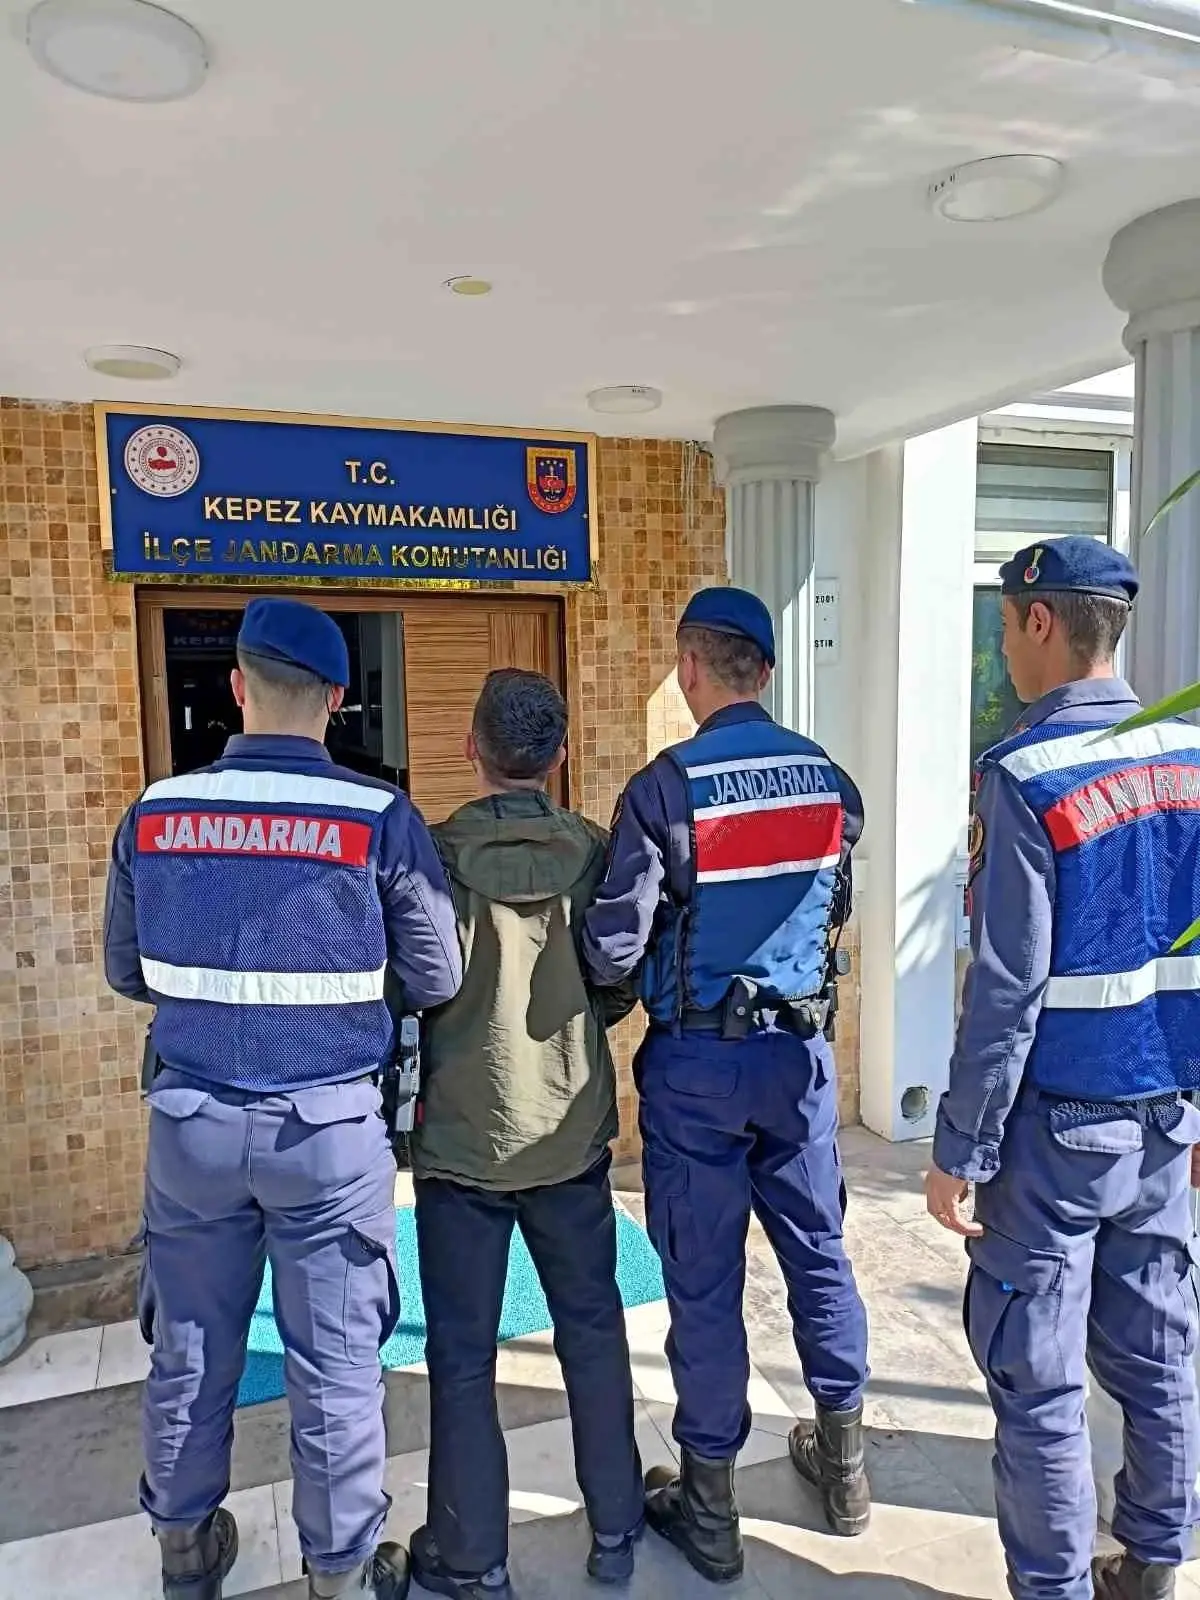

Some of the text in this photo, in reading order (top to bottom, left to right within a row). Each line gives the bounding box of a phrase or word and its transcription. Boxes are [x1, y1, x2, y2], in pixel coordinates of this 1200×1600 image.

[345, 460, 395, 485] T.C.
[204, 496, 517, 531] KEPEZ KAYMAKAMLIĞI
[143, 531, 567, 571] İLÇE JANDARMA KOMUTANLIĞI
[173, 636, 236, 646] KEPE
[709, 765, 829, 805] JANDARMA
[154, 816, 342, 858] JANDARMA
